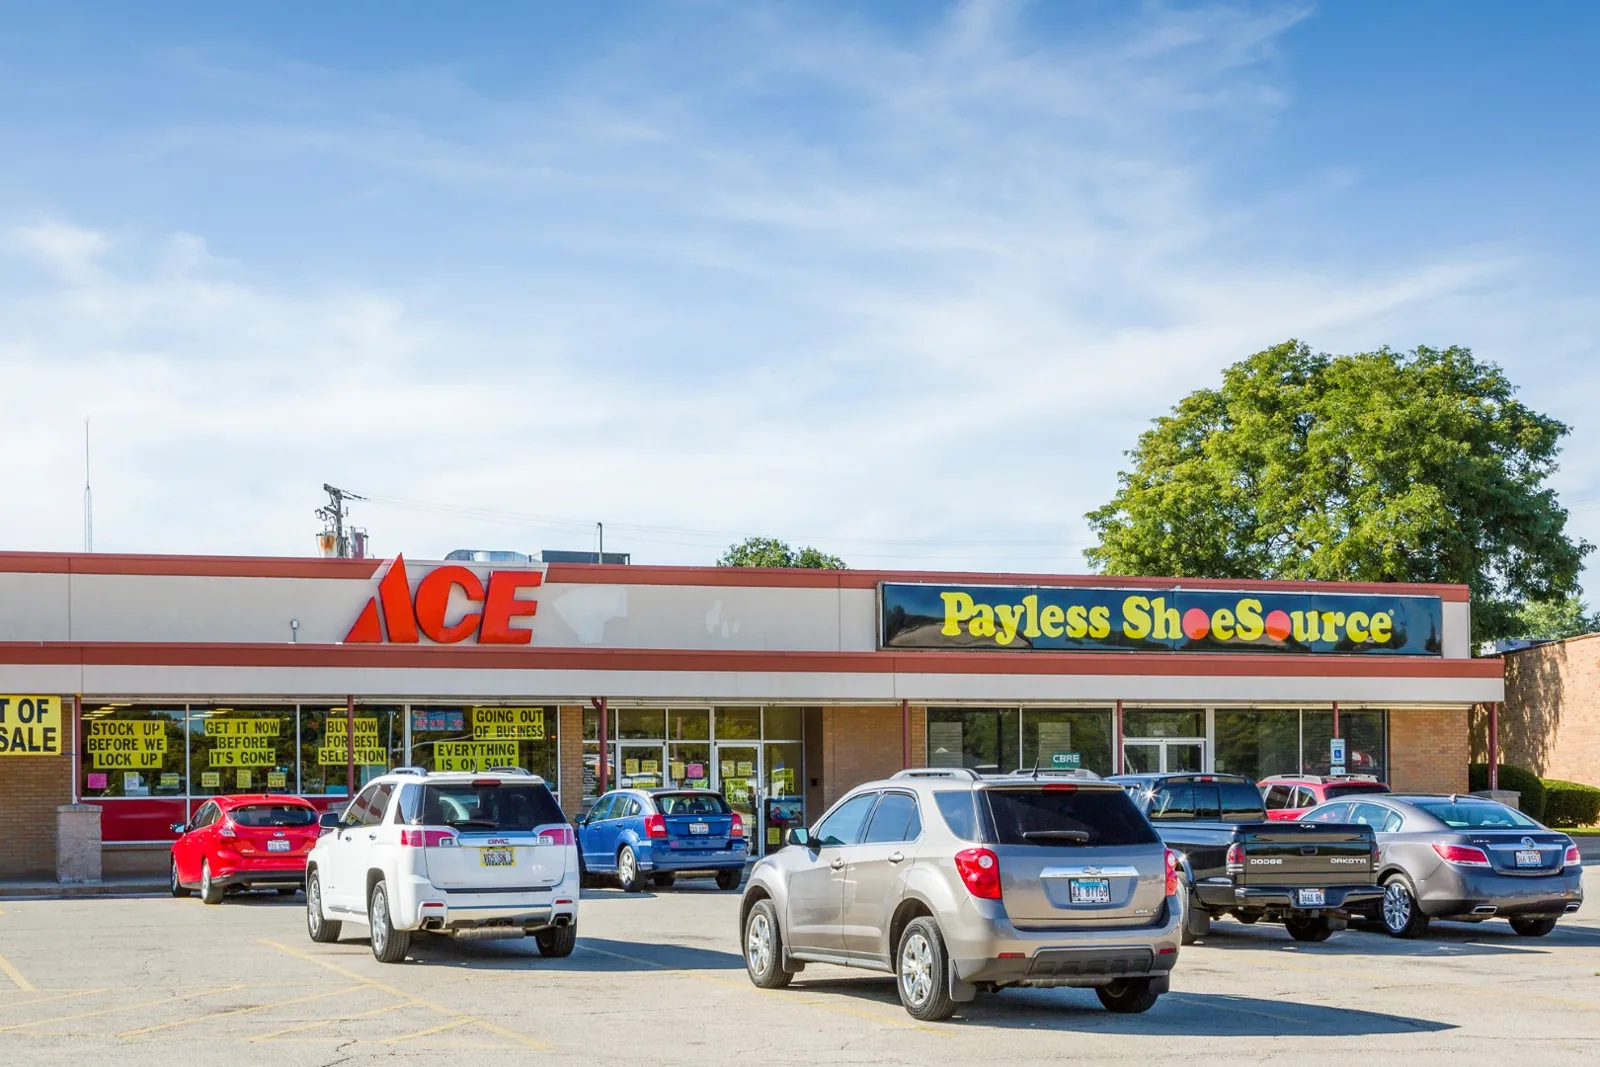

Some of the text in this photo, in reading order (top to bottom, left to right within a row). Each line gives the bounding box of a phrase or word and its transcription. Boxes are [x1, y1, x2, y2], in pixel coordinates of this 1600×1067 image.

[344, 552, 541, 644] ACE
[940, 592, 1110, 645] Payless
[18, 698, 49, 724] OF
[476, 710, 513, 722] GOING
[520, 711, 542, 722] OUT
[92, 723, 160, 735] STOCK UP
[205, 721, 279, 734] GET IT NOW
[354, 721, 376, 733] NOW
[474, 725, 542, 738] OF BUSINESS
[0, 726, 56, 752] SALE
[88, 738, 164, 751] BEFORE WE
[219, 736, 266, 749] BEFORE
[326, 735, 377, 748] FOR BEST
[438, 744, 515, 757] EVERYTHING
[98, 753, 157, 766] LOCK UP
[210, 751, 274, 765] IT'S GONE
[442, 758, 514, 771] IS ON SALE
[1053, 754, 1080, 764] CBRE
